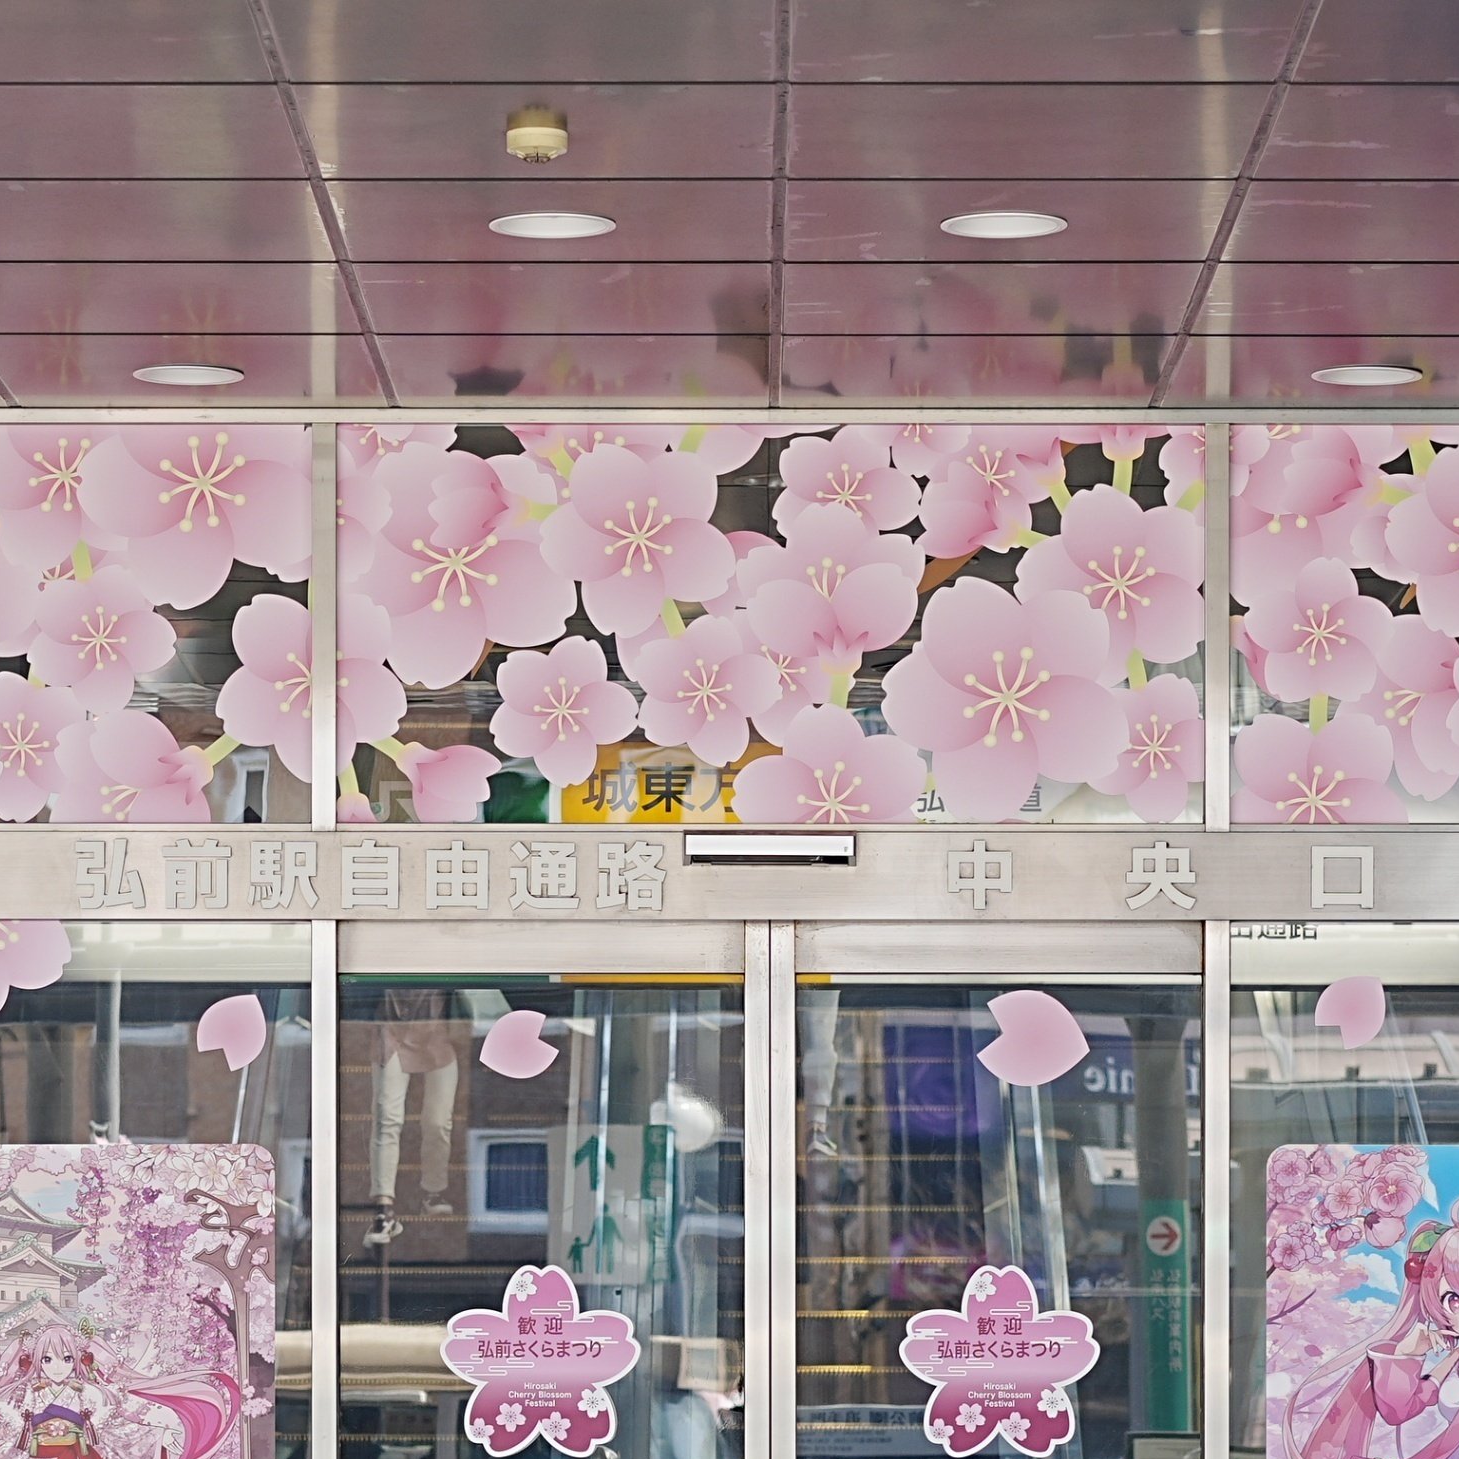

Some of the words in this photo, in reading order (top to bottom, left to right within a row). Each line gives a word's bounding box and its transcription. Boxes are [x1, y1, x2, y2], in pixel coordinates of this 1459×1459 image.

[74, 838, 668, 911] 弘前駅自由通路
[517, 1316, 564, 1336] 歓迎
[976, 1316, 1023, 1336] 歓迎
[478, 1340, 603, 1360] 弘前さくらまつり
[936, 1340, 1062, 1360] 弘前さくらまつり
[523, 1382, 557, 1391] Hirosaki
[983, 1382, 1017, 1391] Hirosaki
[508, 1391, 537, 1401] Cherry
[539, 1391, 572, 1399] Blossom
[968, 1391, 996, 1401] Cherry
[998, 1391, 1032, 1399] Blossom
[524, 1399, 557, 1408] Festival
[984, 1399, 1016, 1408] Festival
